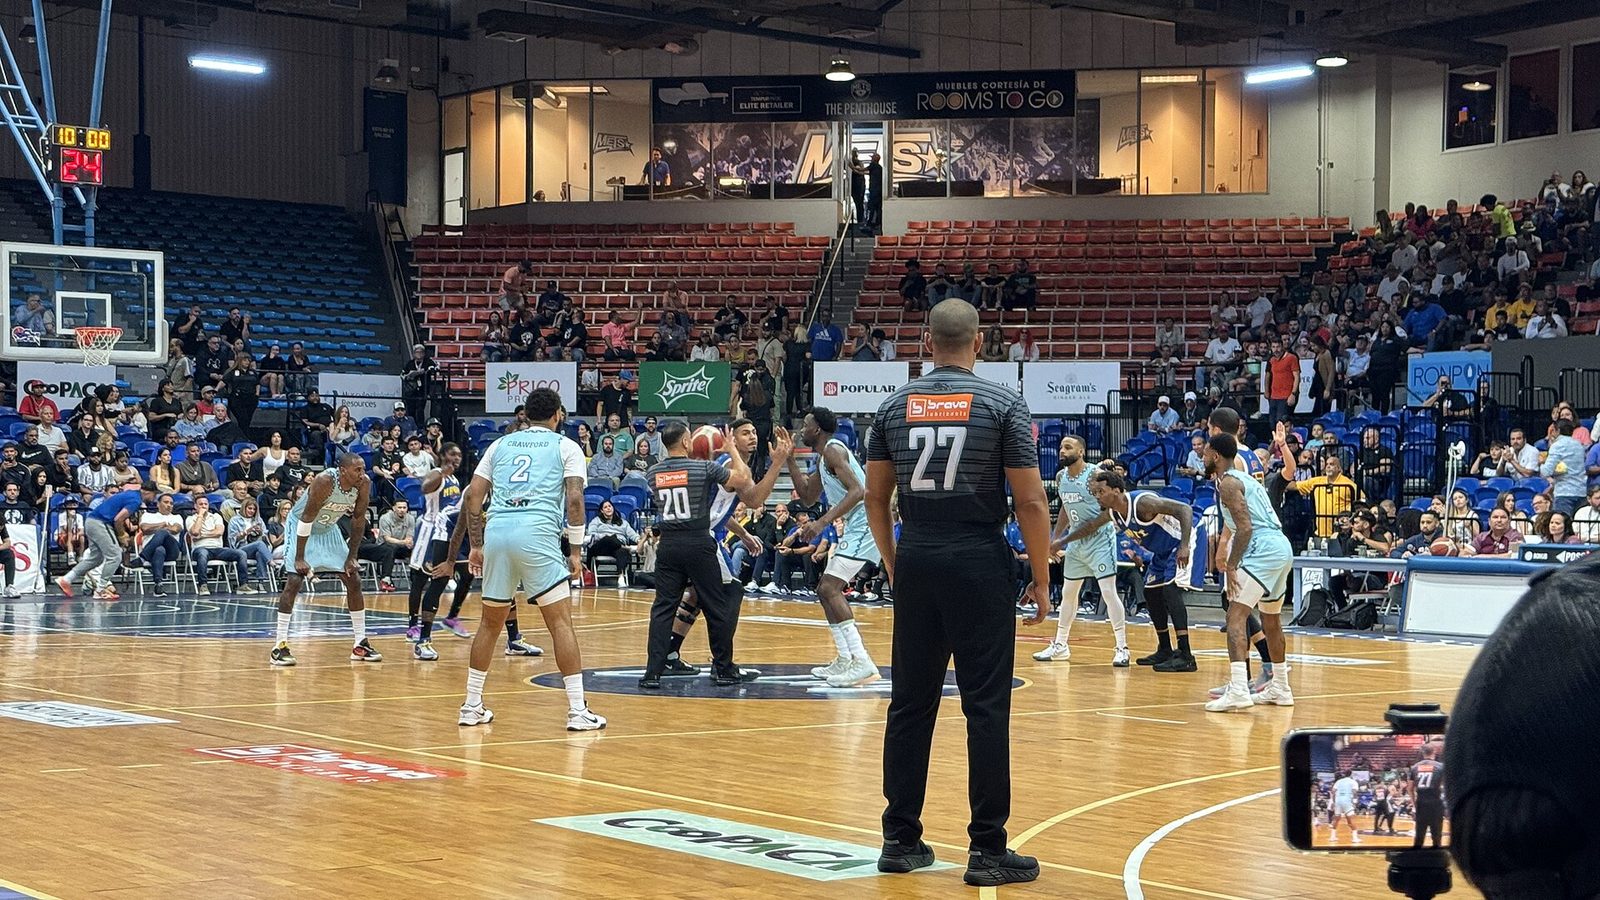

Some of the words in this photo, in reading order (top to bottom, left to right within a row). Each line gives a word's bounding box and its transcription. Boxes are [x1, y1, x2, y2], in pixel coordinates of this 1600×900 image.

[936, 82, 978, 90] MUEBLES
[981, 79, 1029, 89] CORTESÍA
[1033, 80, 1046, 88] DE
[917, 91, 993, 110] ROOMS
[997, 91, 1024, 109] TO
[1028, 90, 1064, 109] GO
[825, 103, 842, 115] THE
[844, 102, 897, 114] PENTHOUSE
[63, 150, 100, 182] 24
[662, 378, 706, 397] Sprite
[840, 384, 896, 393] POPULAR
[1046, 381, 1097, 394] Seagram's
[507, 440, 550, 449] CRAWFORD
[908, 426, 968, 491] 27
[508, 454, 533, 484] 2
[658, 487, 692, 520] 20
[1070, 509, 1080, 522] 6
[1417, 772, 1433, 788] 27
